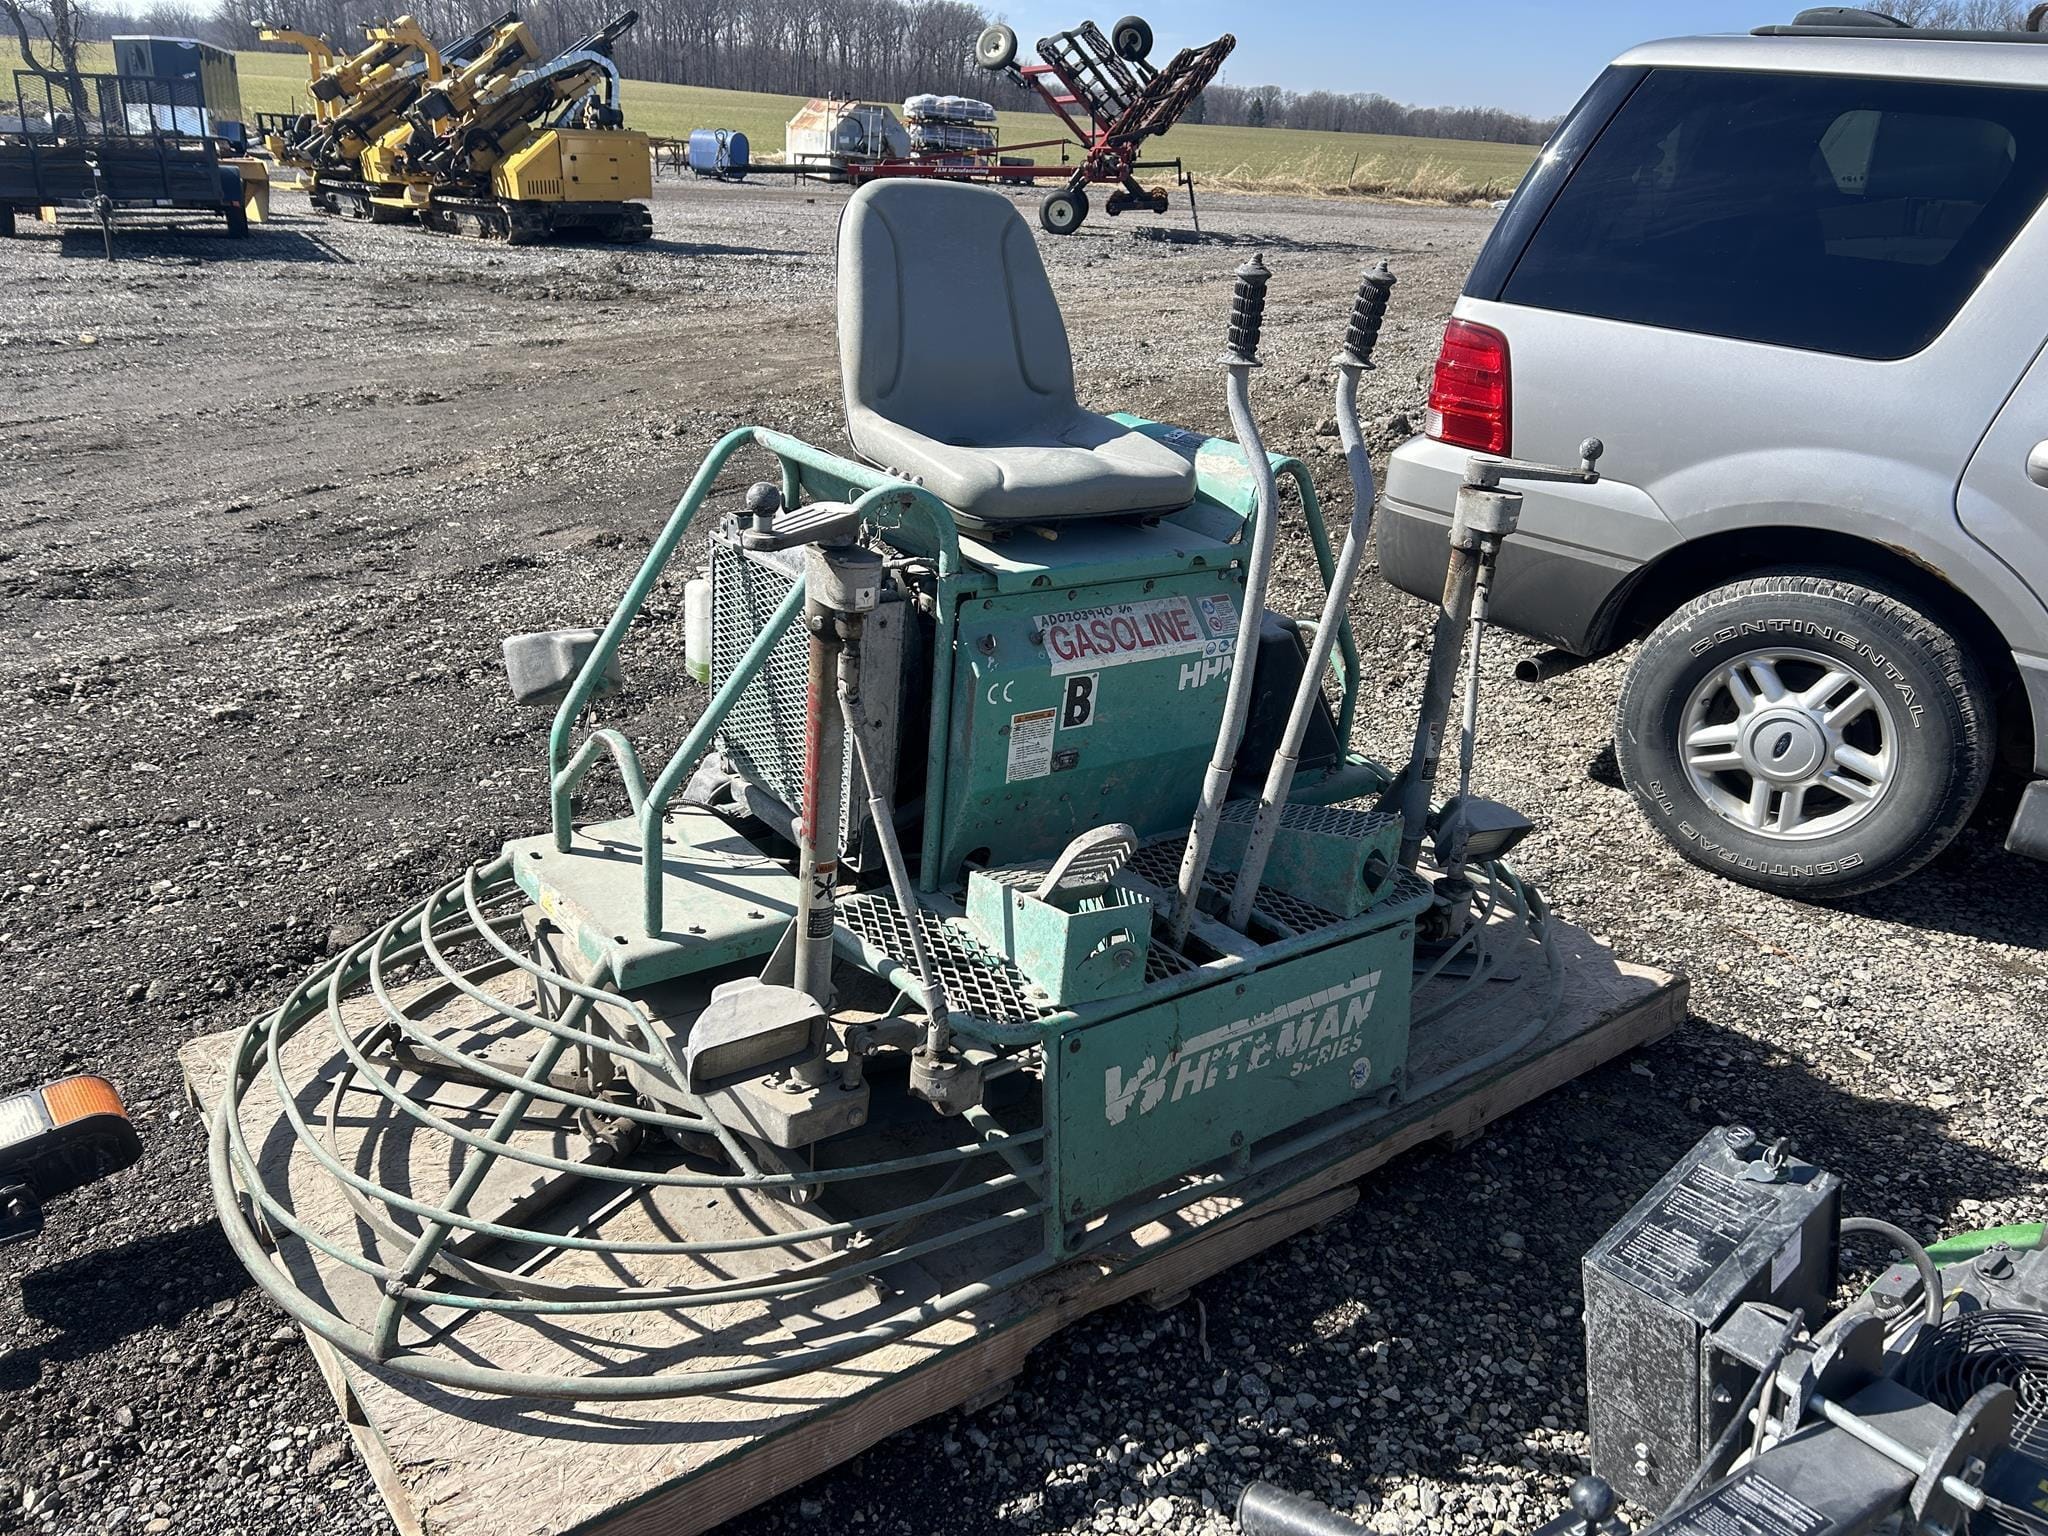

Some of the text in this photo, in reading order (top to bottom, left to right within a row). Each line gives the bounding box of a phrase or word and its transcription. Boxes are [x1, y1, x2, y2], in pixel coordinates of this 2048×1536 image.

[1050, 609, 1197, 660] GASOLINE
[1063, 676, 1093, 728] B
[1689, 619, 1925, 728] CONTINENTAL
[1650, 780, 1864, 877] CONTITRAC TR
